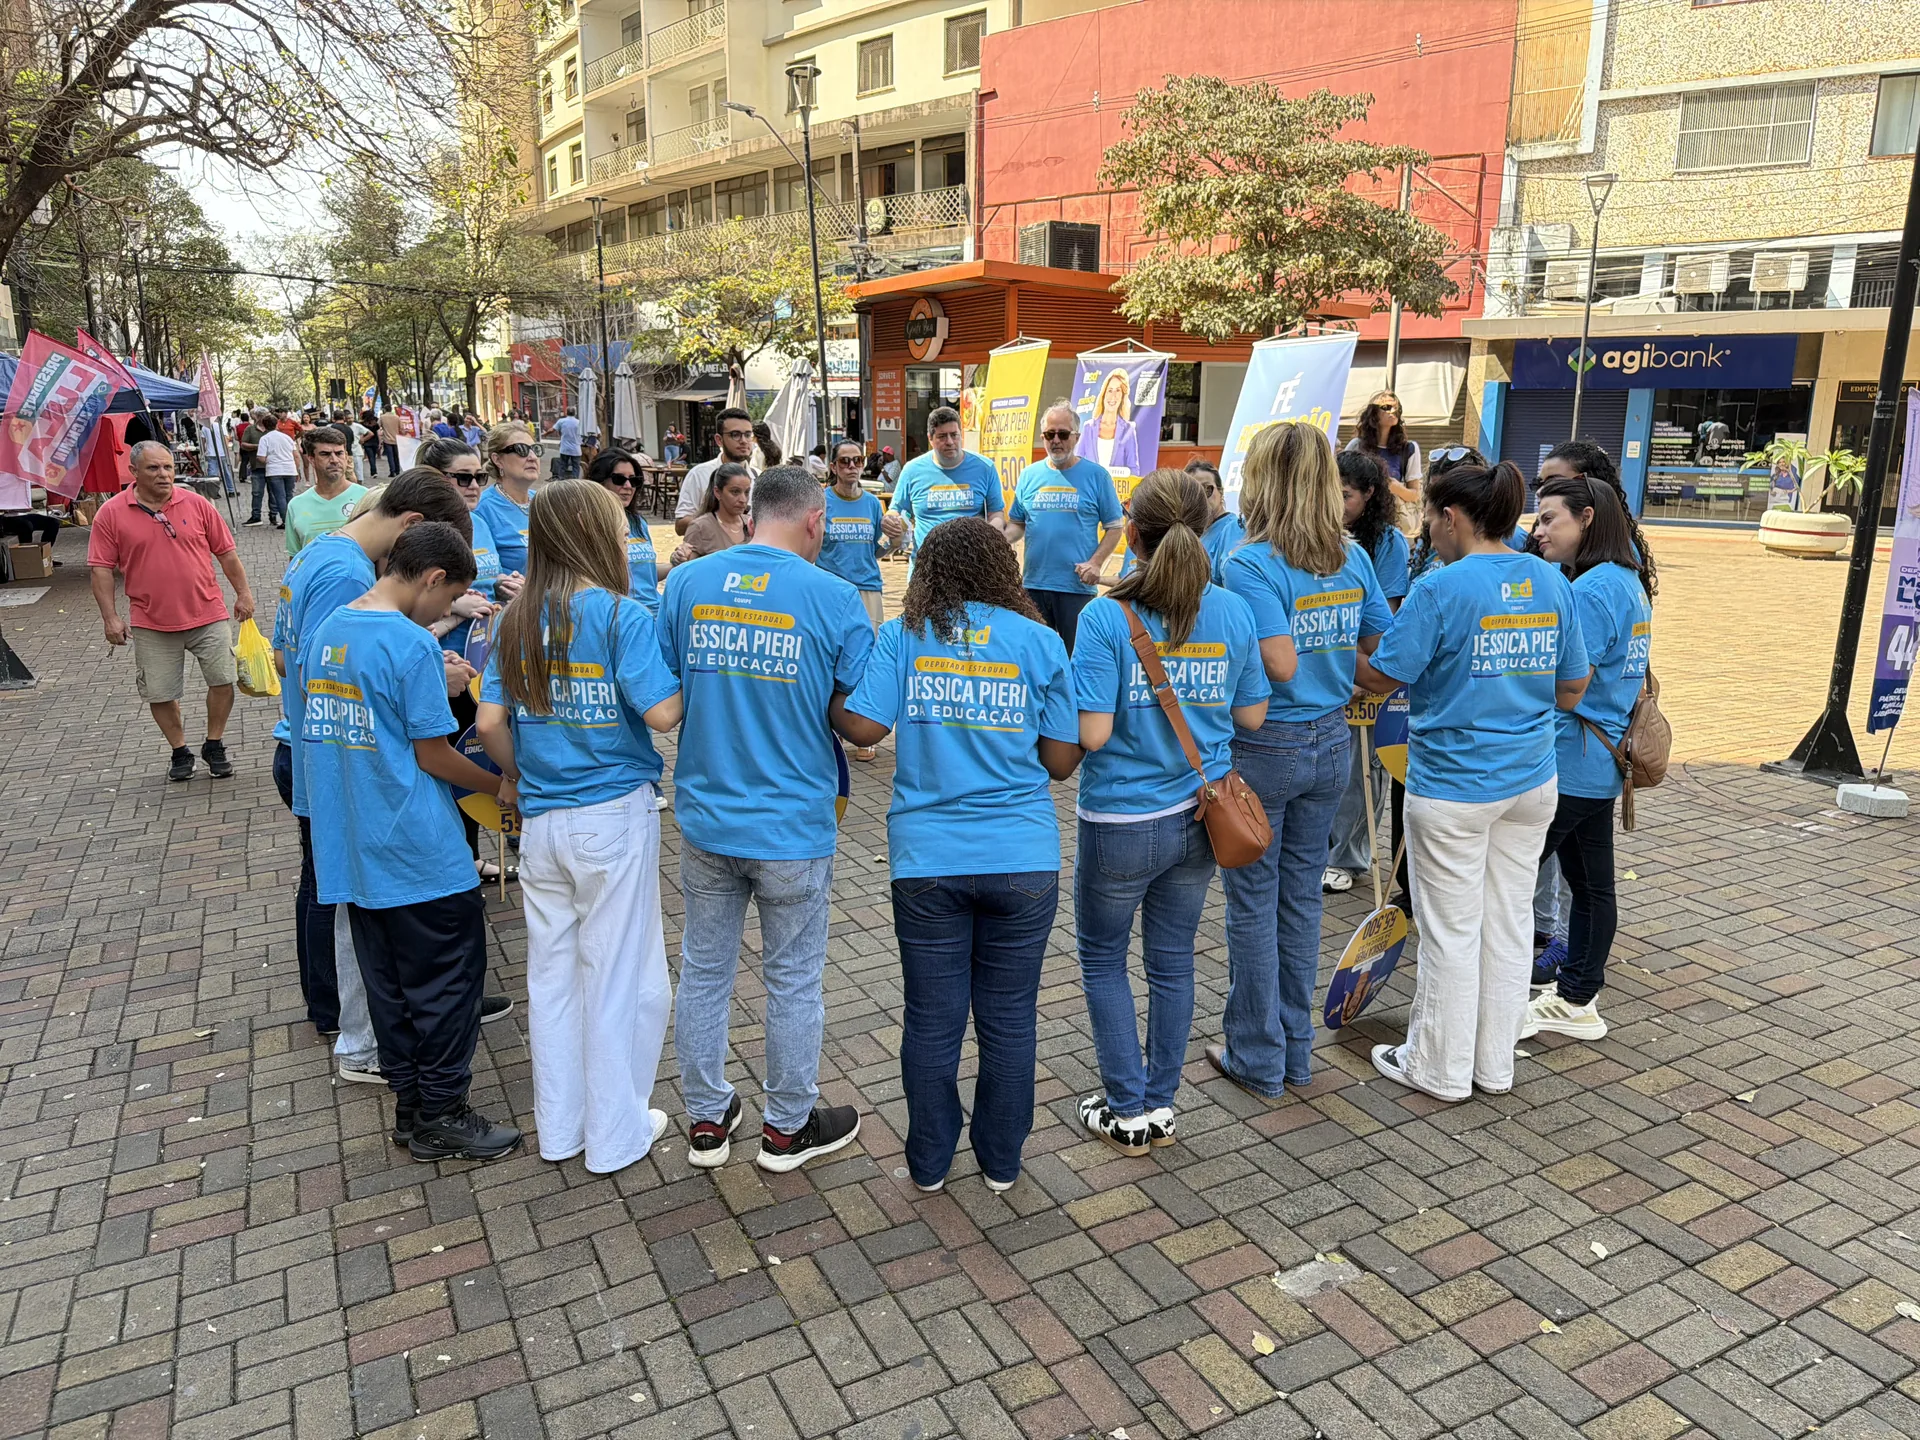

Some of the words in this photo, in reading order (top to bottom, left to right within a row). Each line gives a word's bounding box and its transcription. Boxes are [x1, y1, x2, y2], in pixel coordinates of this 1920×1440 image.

[1602, 343, 1723, 374] agibank
[1270, 372, 1304, 415] FÉ
[1850, 385, 1879, 393] EDIFÍCI
[1034, 491, 1060, 502] JÉSSICA
[1061, 492, 1079, 502] PIERI
[1042, 502, 1078, 510] EDUCAÇÃO
[830, 522, 857, 534] JÉSSICA
[723, 572, 770, 592] psd
[1501, 578, 1533, 602] psd
[1332, 592, 1360, 601] ESTADUAL
[700, 608, 740, 618] DEPUTADA
[744, 613, 783, 624] ESTADUAL
[1342, 606, 1361, 629] PIE
[1520, 616, 1553, 625] ESTADUAL
[689, 620, 748, 652] JÉSSICA
[753, 630, 802, 659] PIERI
[1305, 631, 1357, 647] EDUCAÇ
[1472, 629, 1528, 657] JÉSSICA
[1532, 630, 1559, 654] PIE
[321, 643, 348, 666] psd
[1183, 646, 1216, 654] STADUAL
[707, 653, 798, 674] EDUCAÇÃO
[924, 661, 965, 671] DEPUTADA
[969, 665, 1008, 674] ESTADUAL
[1471, 660, 1492, 671] DA
[1496, 653, 1557, 670] EDUCAÇÃ
[309, 682, 335, 690] EPUTADA
[571, 681, 617, 705] PIERI
[907, 672, 974, 704] JÉSSICA
[979, 681, 1028, 708] PIERI
[1130, 689, 1150, 701] DA
[1397, 691, 1405, 699] FÉ
[341, 702, 375, 729] PIERI
[908, 705, 925, 717] DA
[932, 705, 1024, 725] EDUCAÇÃO
[1362, 908, 1399, 940] 55.500
